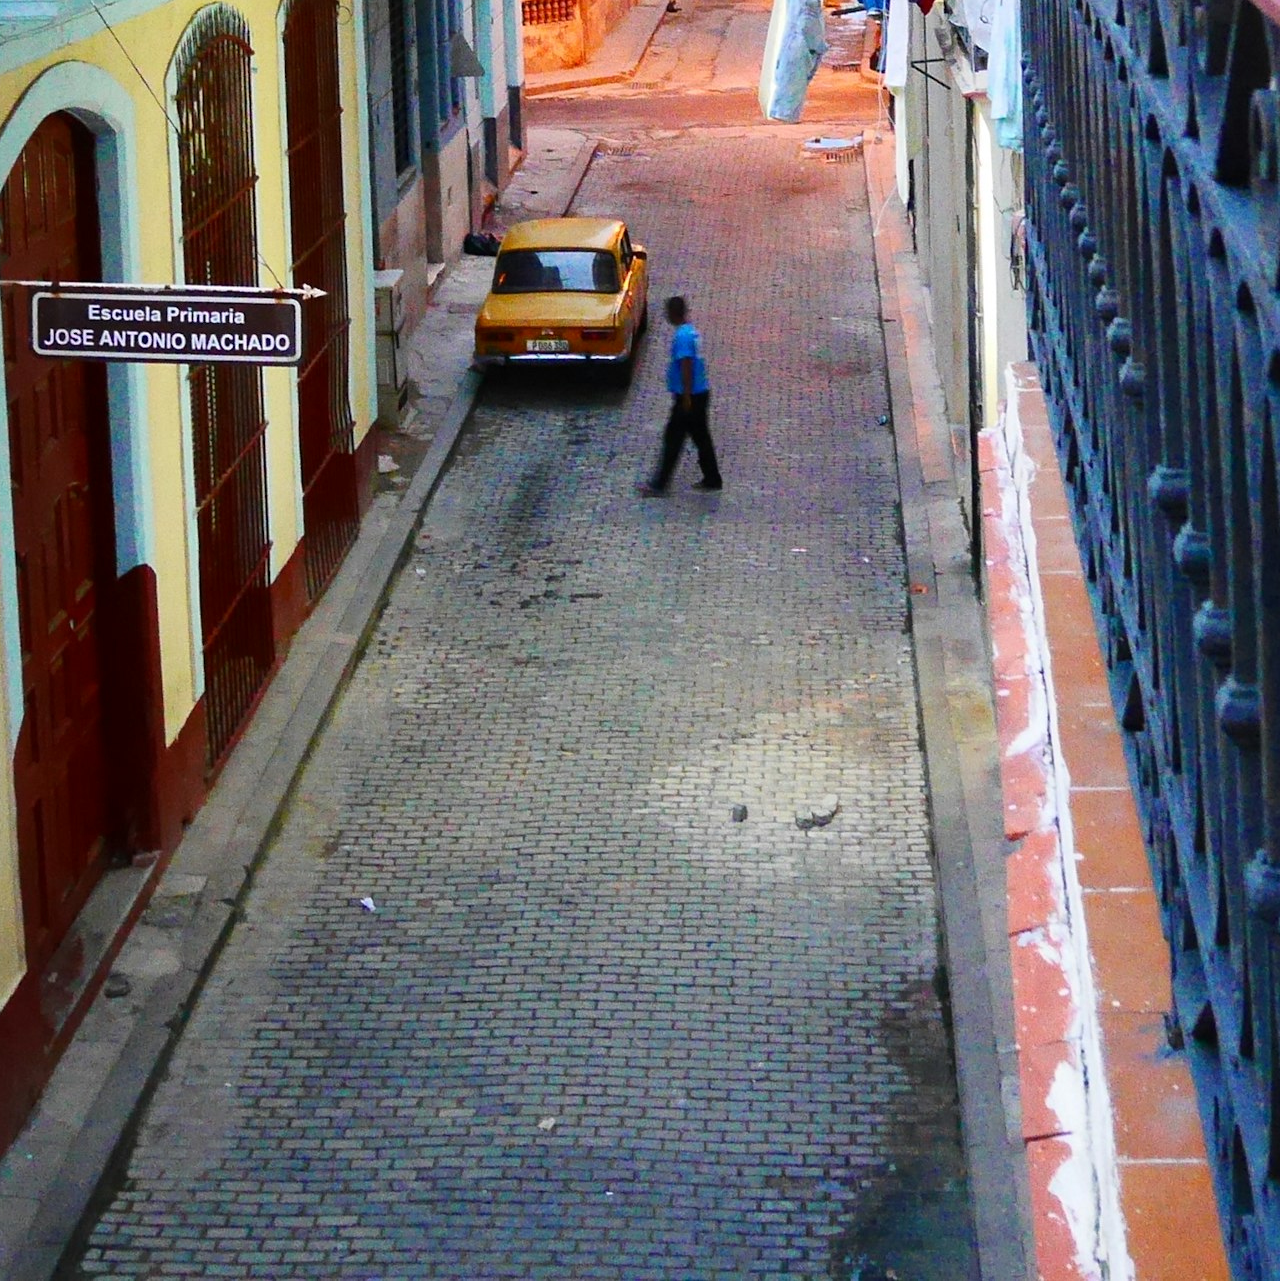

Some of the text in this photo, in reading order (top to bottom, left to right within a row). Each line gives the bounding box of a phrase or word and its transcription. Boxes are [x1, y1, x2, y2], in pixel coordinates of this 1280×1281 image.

[88, 304, 245, 324] Escuela Primaria
[44, 328, 290, 351] JOSE ANTONIO MACHADO
